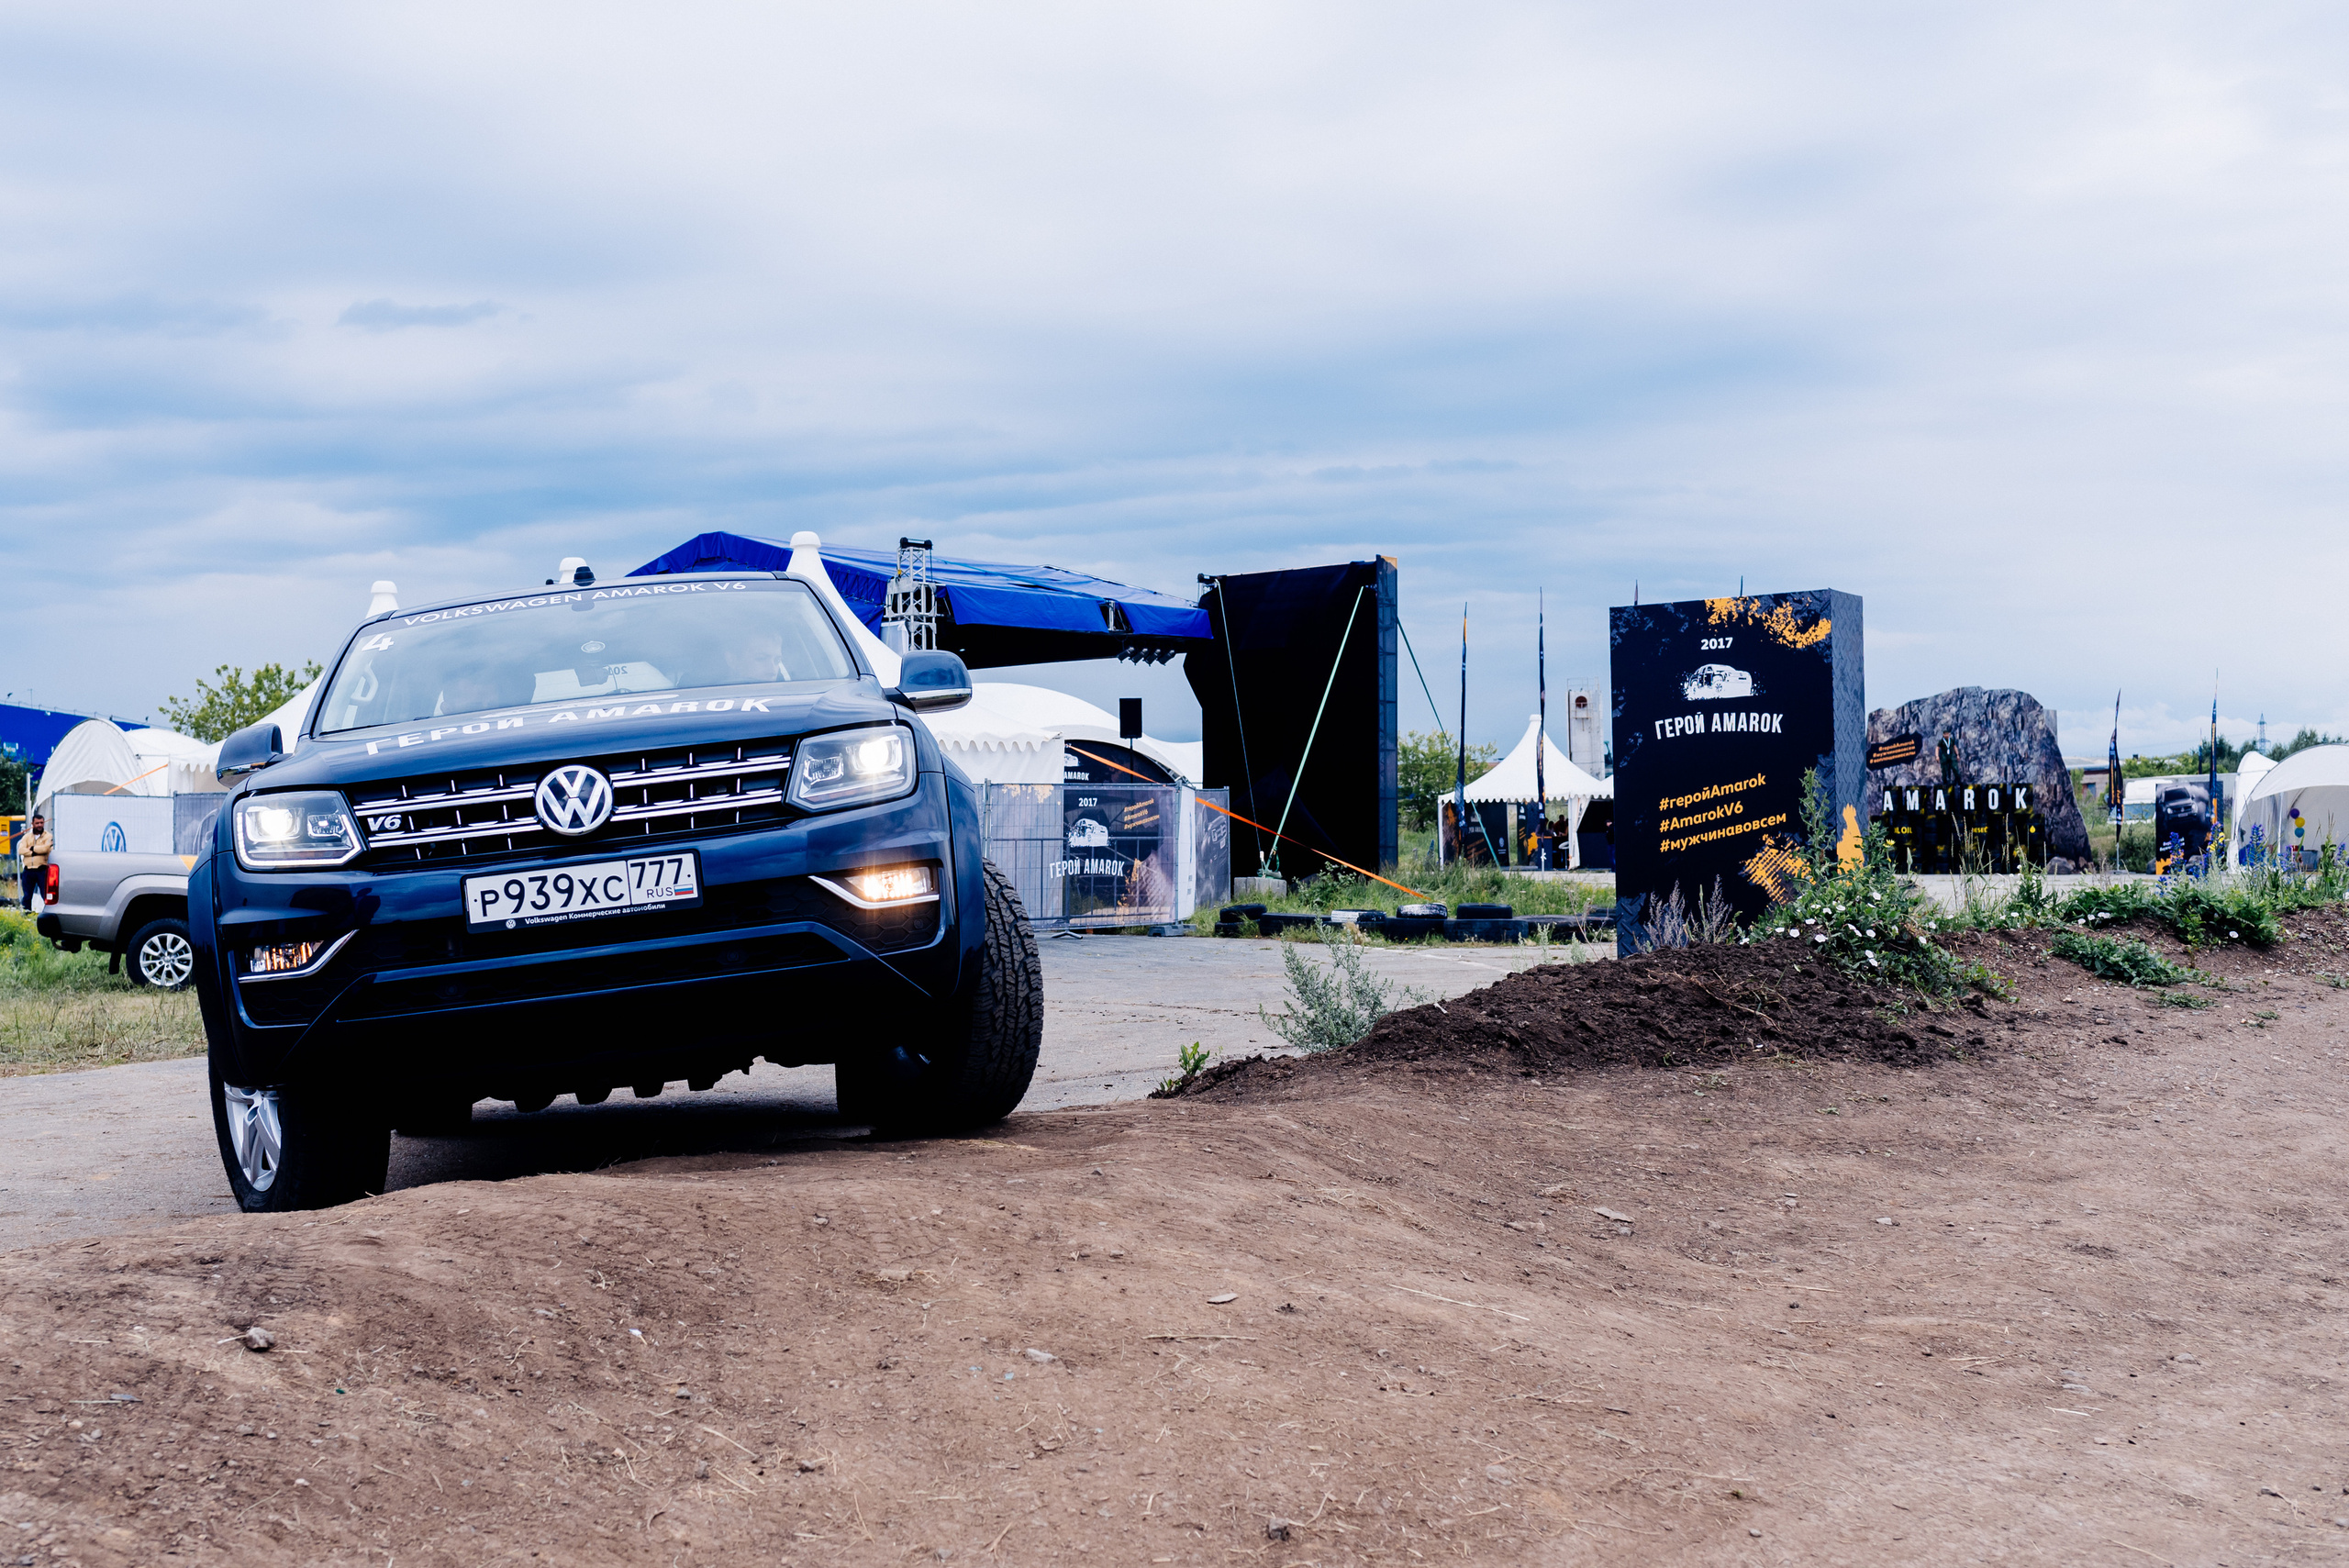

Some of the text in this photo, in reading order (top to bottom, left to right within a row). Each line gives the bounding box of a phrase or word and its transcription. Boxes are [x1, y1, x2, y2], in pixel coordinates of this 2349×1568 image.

[404, 582, 746, 626] VOLKSWAGEN AMAROK V6
[362, 633, 395, 651] 4
[1700, 637, 1733, 651] 2017
[548, 698, 774, 724] AMAROK
[1654, 711, 1784, 740] ГЕРОЙ AMAROK
[1064, 772, 1090, 781] AMAROK
[1078, 797, 1098, 807] 2017
[1659, 773, 1766, 812] #геройAmarok
[1883, 787, 2027, 811] AMAROK
[367, 814, 402, 831] V6
[1659, 800, 1744, 833] #AmarokV6
[1660, 813, 1787, 852] #мужчинавовсем
[629, 858, 683, 889] 777
[1050, 856, 1125, 879] ГЕРОЙ AMAROK
[646, 886, 674, 898] RUS
[524, 903, 666, 925] Volkswagen Коммерческие автомобили
